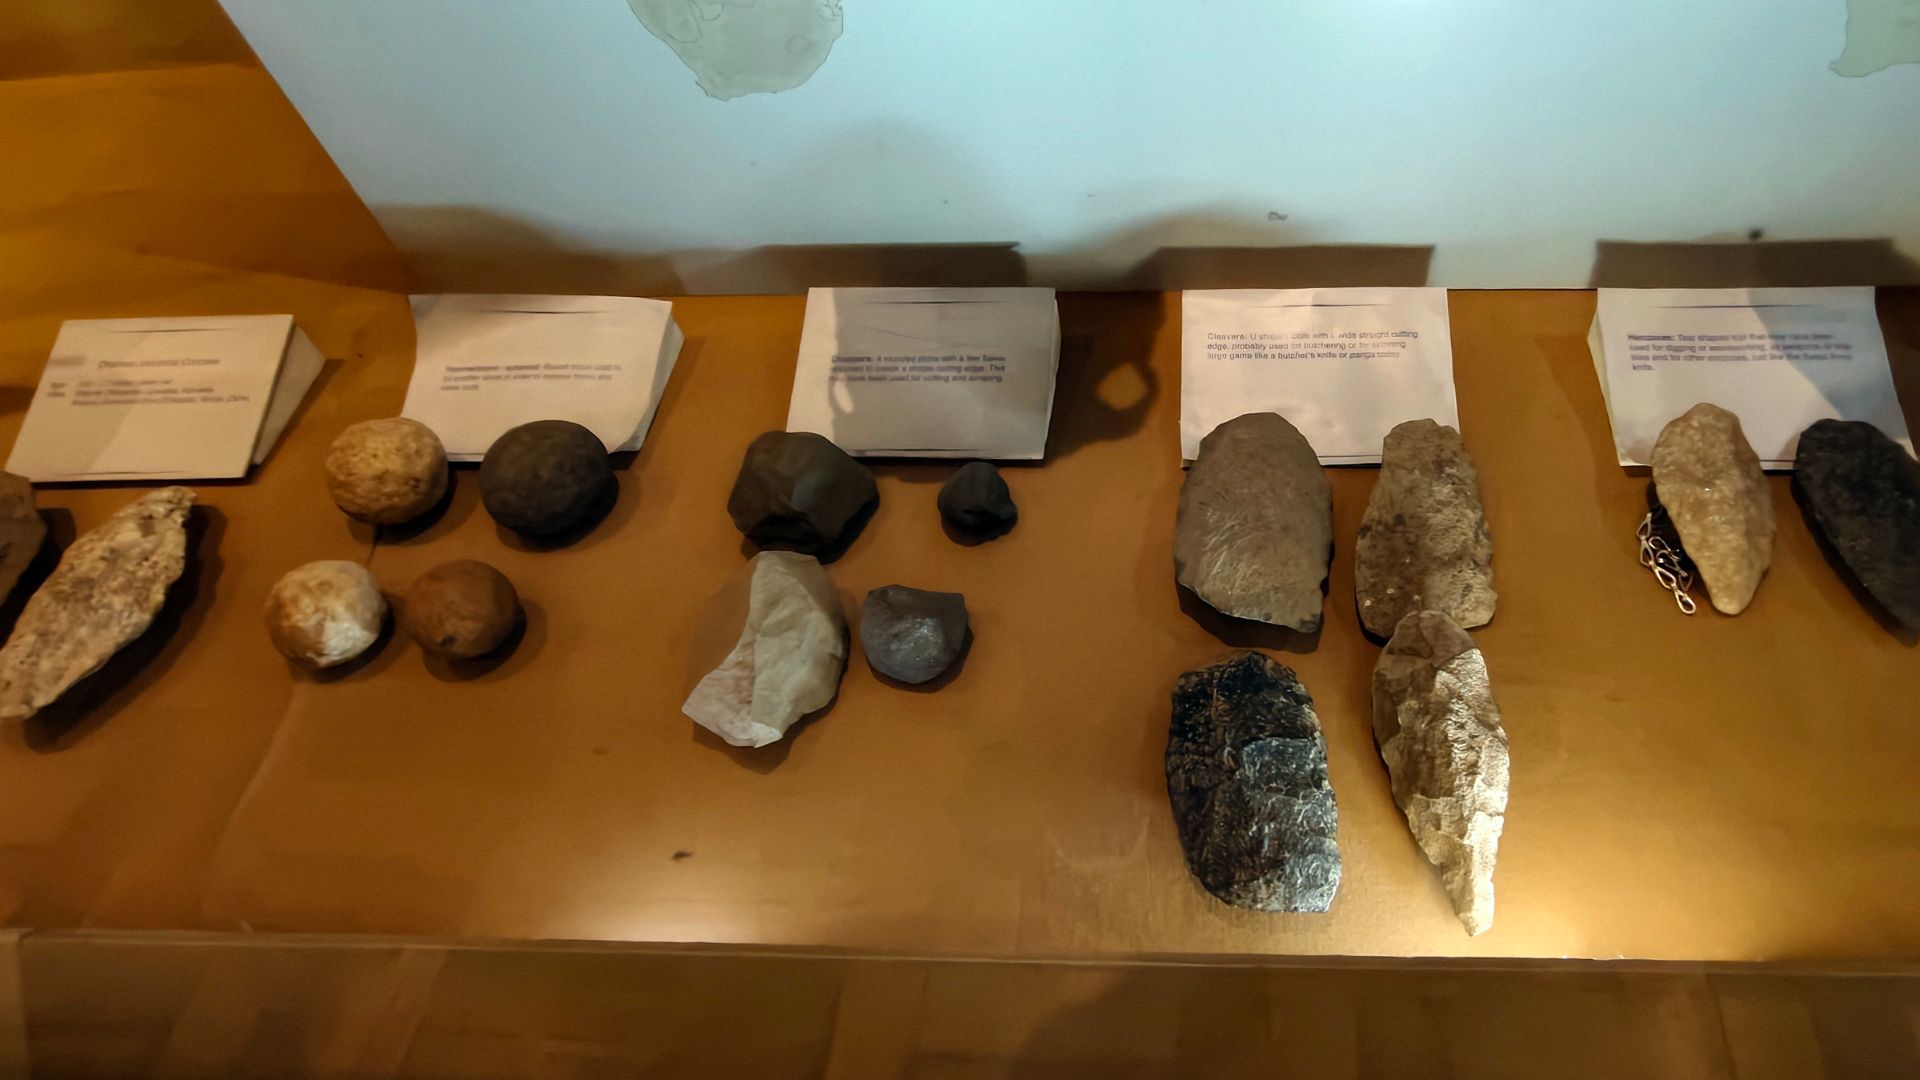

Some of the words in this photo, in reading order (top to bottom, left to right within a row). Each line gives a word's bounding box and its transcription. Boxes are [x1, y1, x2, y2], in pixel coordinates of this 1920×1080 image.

[1231, 342, 1266, 351] probably
[1269, 342, 1289, 350] used
[1229, 352, 1252, 361] game
[1254, 351, 1269, 360] like
[1277, 351, 1316, 360] butcher's
[1316, 351, 1337, 359] knife
